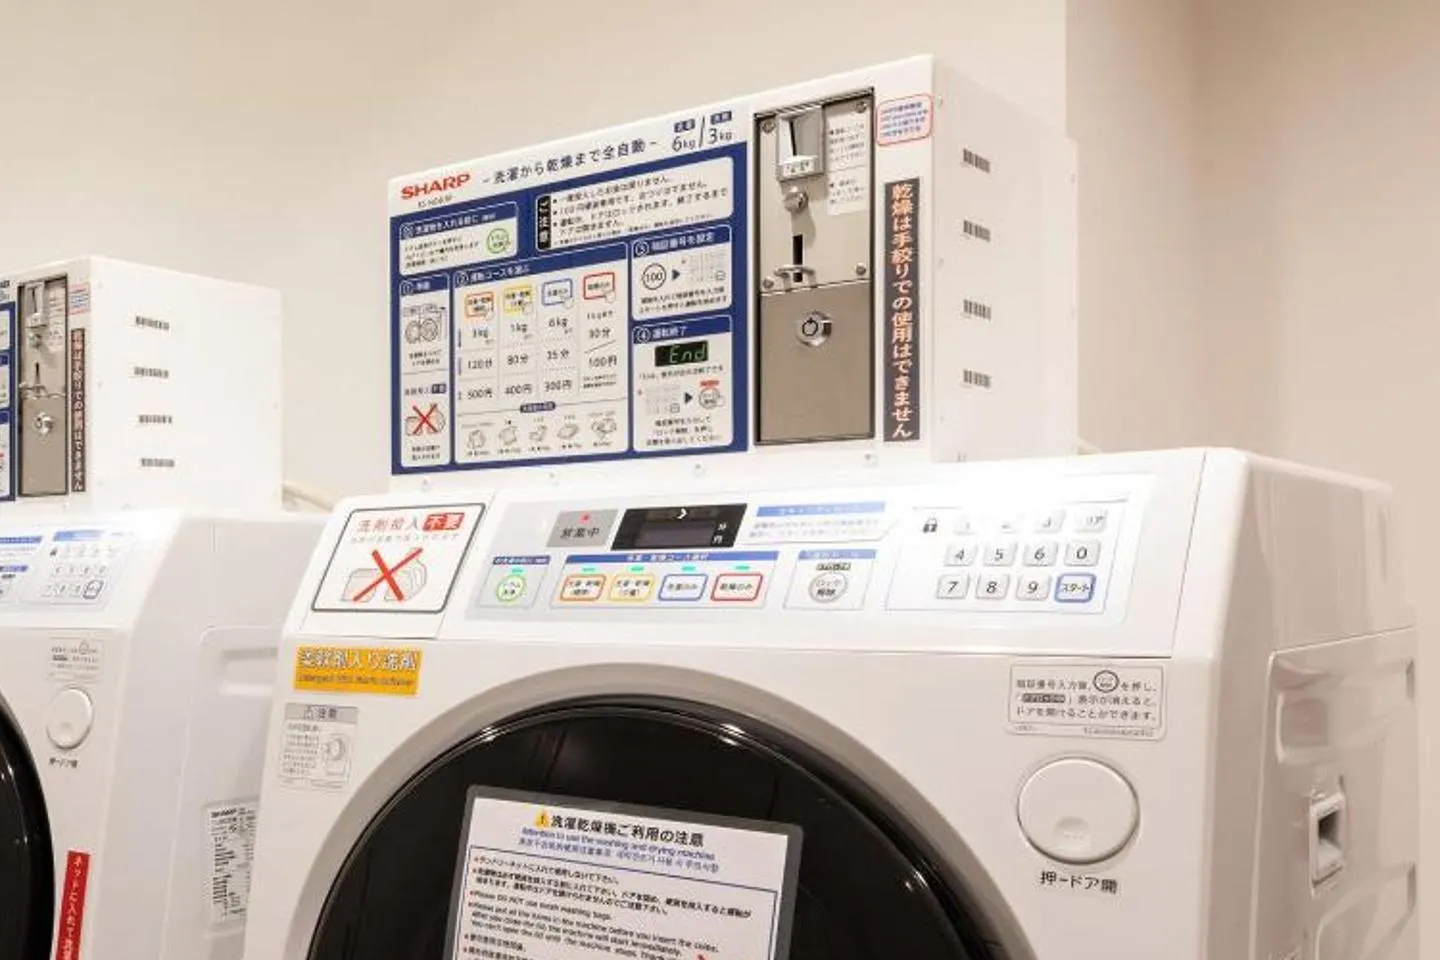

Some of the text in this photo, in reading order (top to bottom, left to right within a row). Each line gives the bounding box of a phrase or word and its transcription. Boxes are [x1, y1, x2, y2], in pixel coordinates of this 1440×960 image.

[671, 133, 695, 154] 6kg
[709, 122, 732, 145] 3kg
[400, 173, 471, 201] SHARP
[670, 341, 707, 364] End
[505, 383, 532, 396] 400円
[954, 548, 965, 560] 4
[993, 548, 1005, 560] 5
[1034, 547, 1046, 560] 6
[947, 580, 959, 594] 7
[985, 581, 998, 594] 8
[1027, 581, 1039, 594] 9
[550, 814, 704, 847] 洗濯乾燥機ご利用の注意
